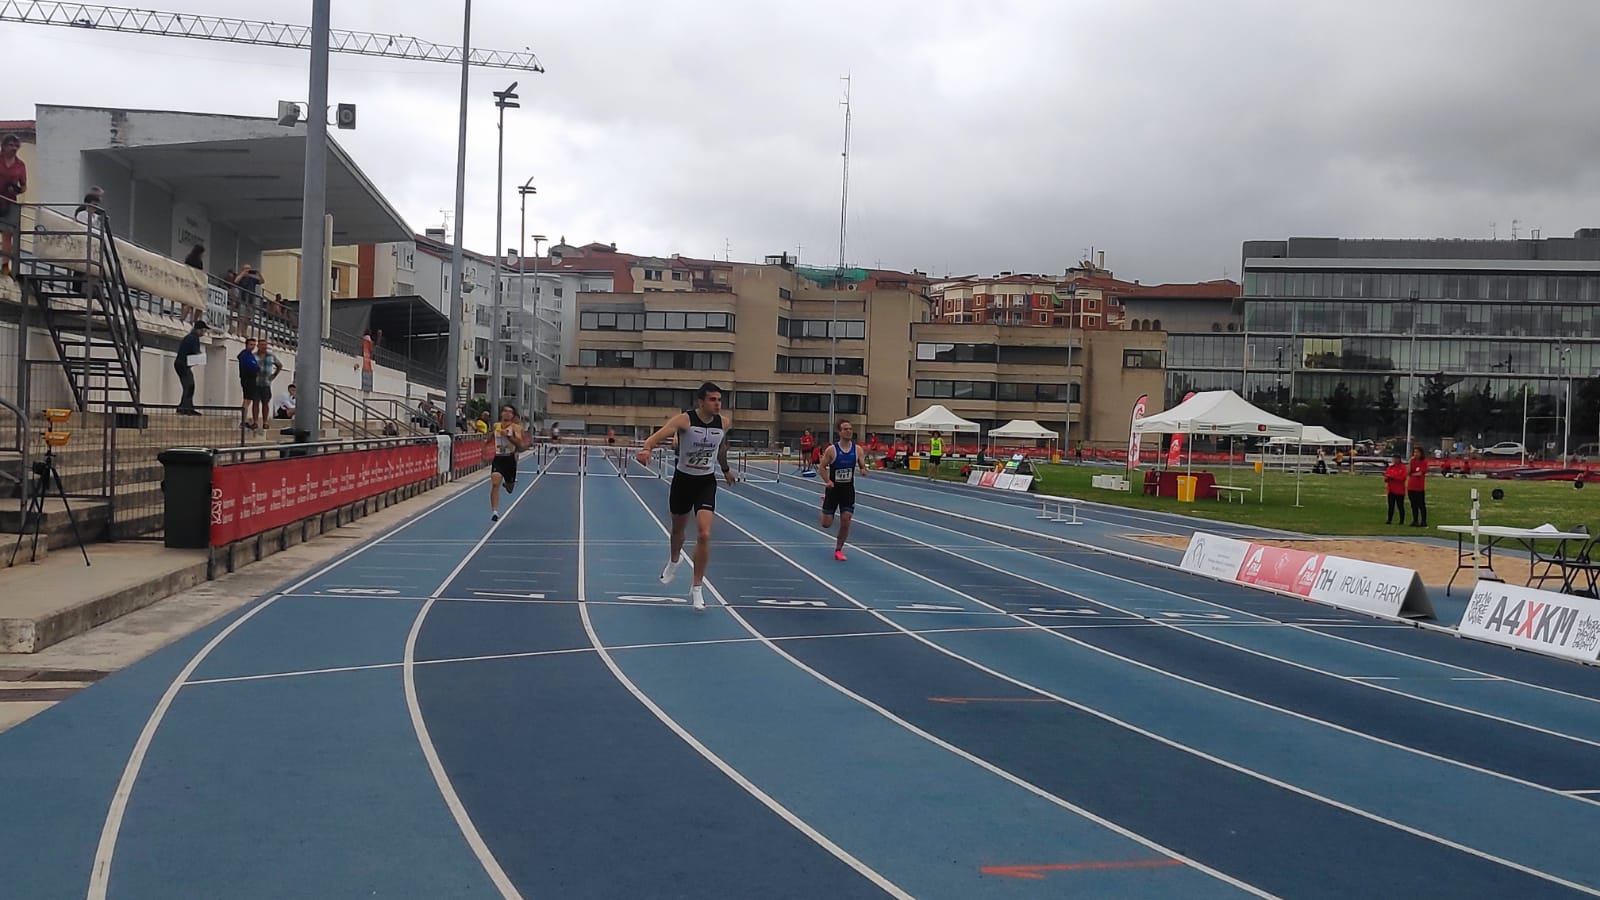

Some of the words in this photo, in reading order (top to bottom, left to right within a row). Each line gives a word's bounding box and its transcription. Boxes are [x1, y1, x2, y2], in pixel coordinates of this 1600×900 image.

[1339, 574, 1372, 597] IRUÑA
[1373, 582, 1406, 605] PARK
[1484, 595, 1580, 647] A4XKM
